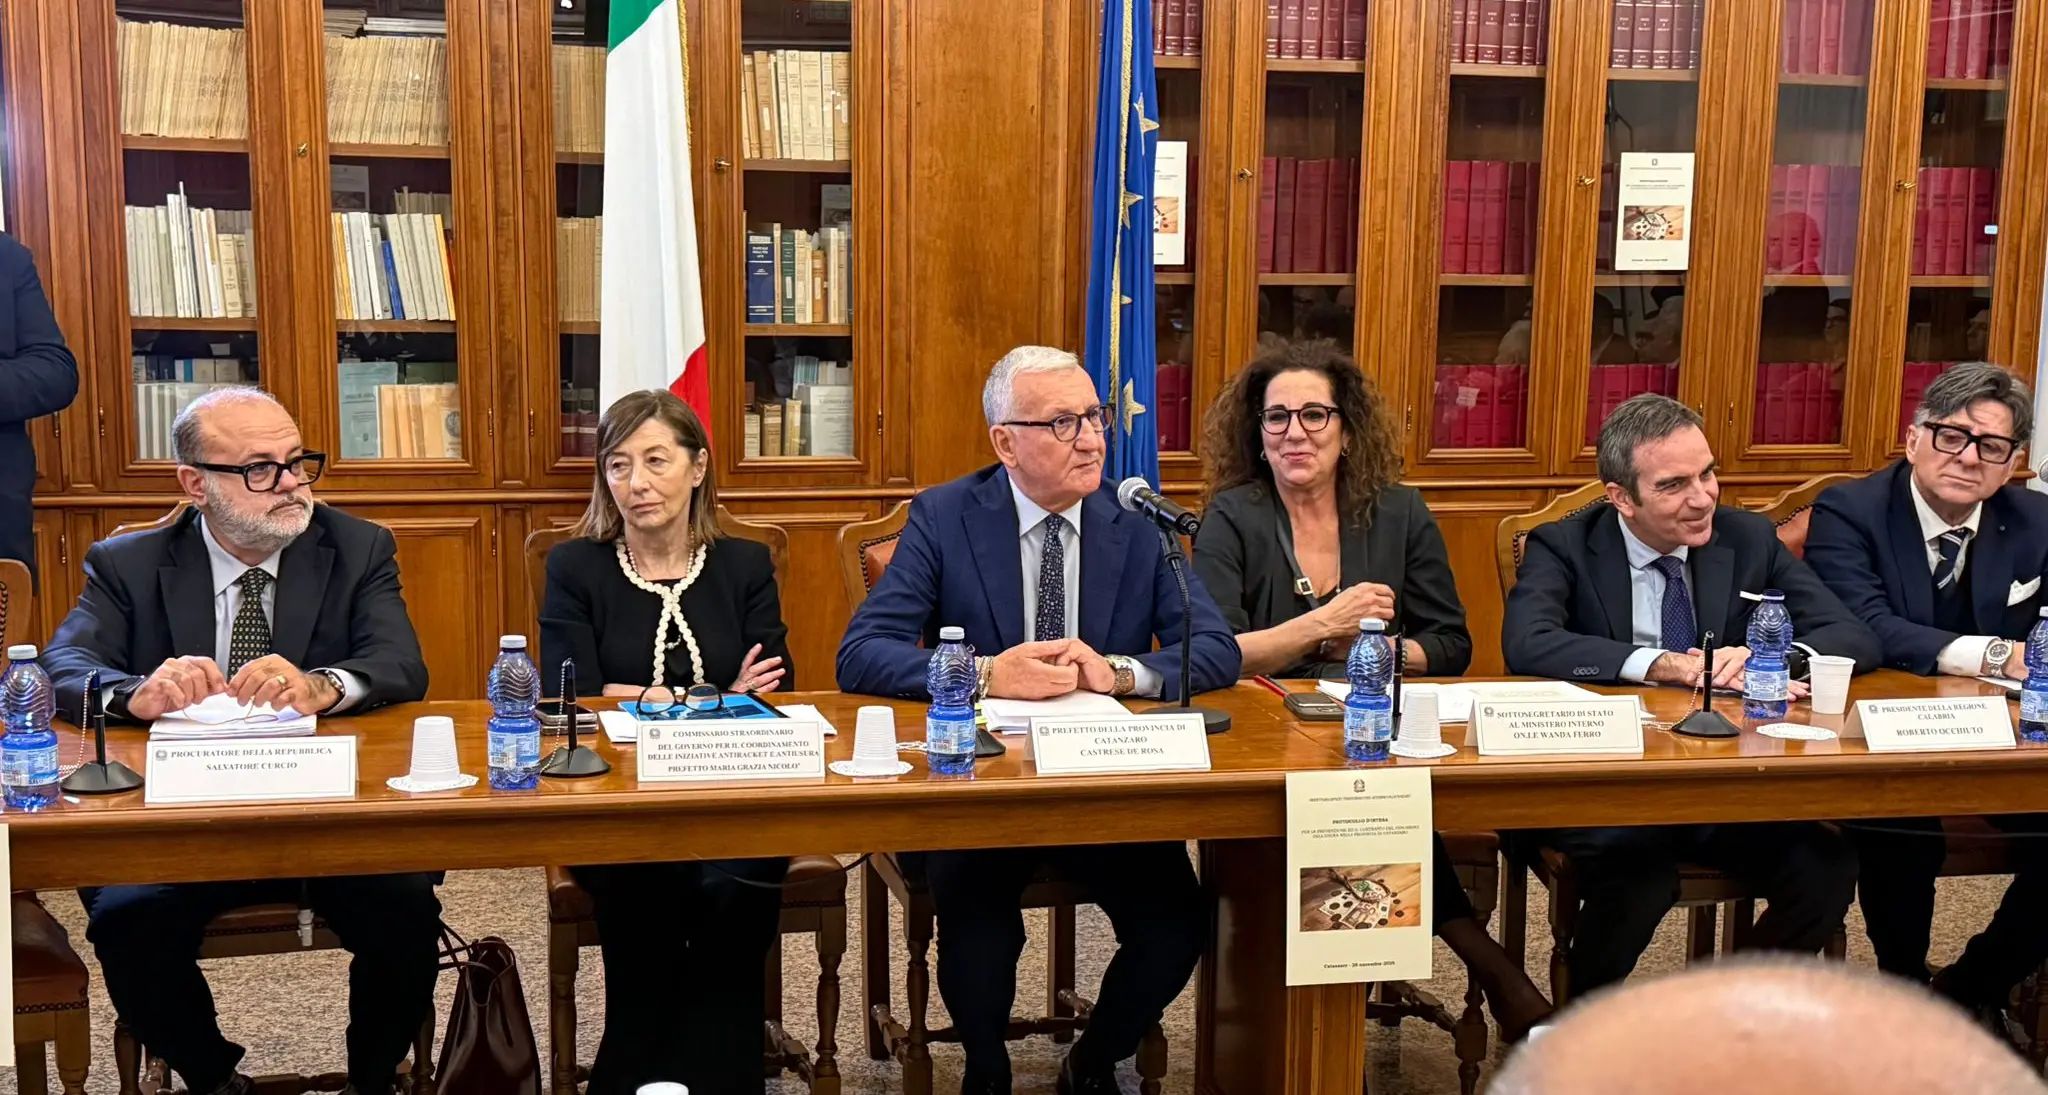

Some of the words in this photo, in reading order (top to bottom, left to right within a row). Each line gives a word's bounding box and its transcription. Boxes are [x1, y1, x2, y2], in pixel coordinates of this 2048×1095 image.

[1882, 705, 1928, 713] PRESIDENTE
[1052, 726, 1097, 734] PREFETTO
[1128, 724, 1174, 732] PROVINCIA
[1896, 728, 1938, 736] ROBERTO
[1938, 727, 1984, 735] OCCHIUTO
[740, 740, 809, 748] COORDINAMENTO
[170, 750, 241, 758] PROCURATORE
[242, 748, 273, 757] DELLA
[274, 748, 332, 756] REPUBBLICA
[718, 751, 768, 759] ANTIRACKET
[1080, 748, 1126, 756] CASTRESE
[206, 762, 260, 770] SALVATORE
[261, 762, 298, 770] CURCIO
[668, 764, 708, 772] PREFETTO
